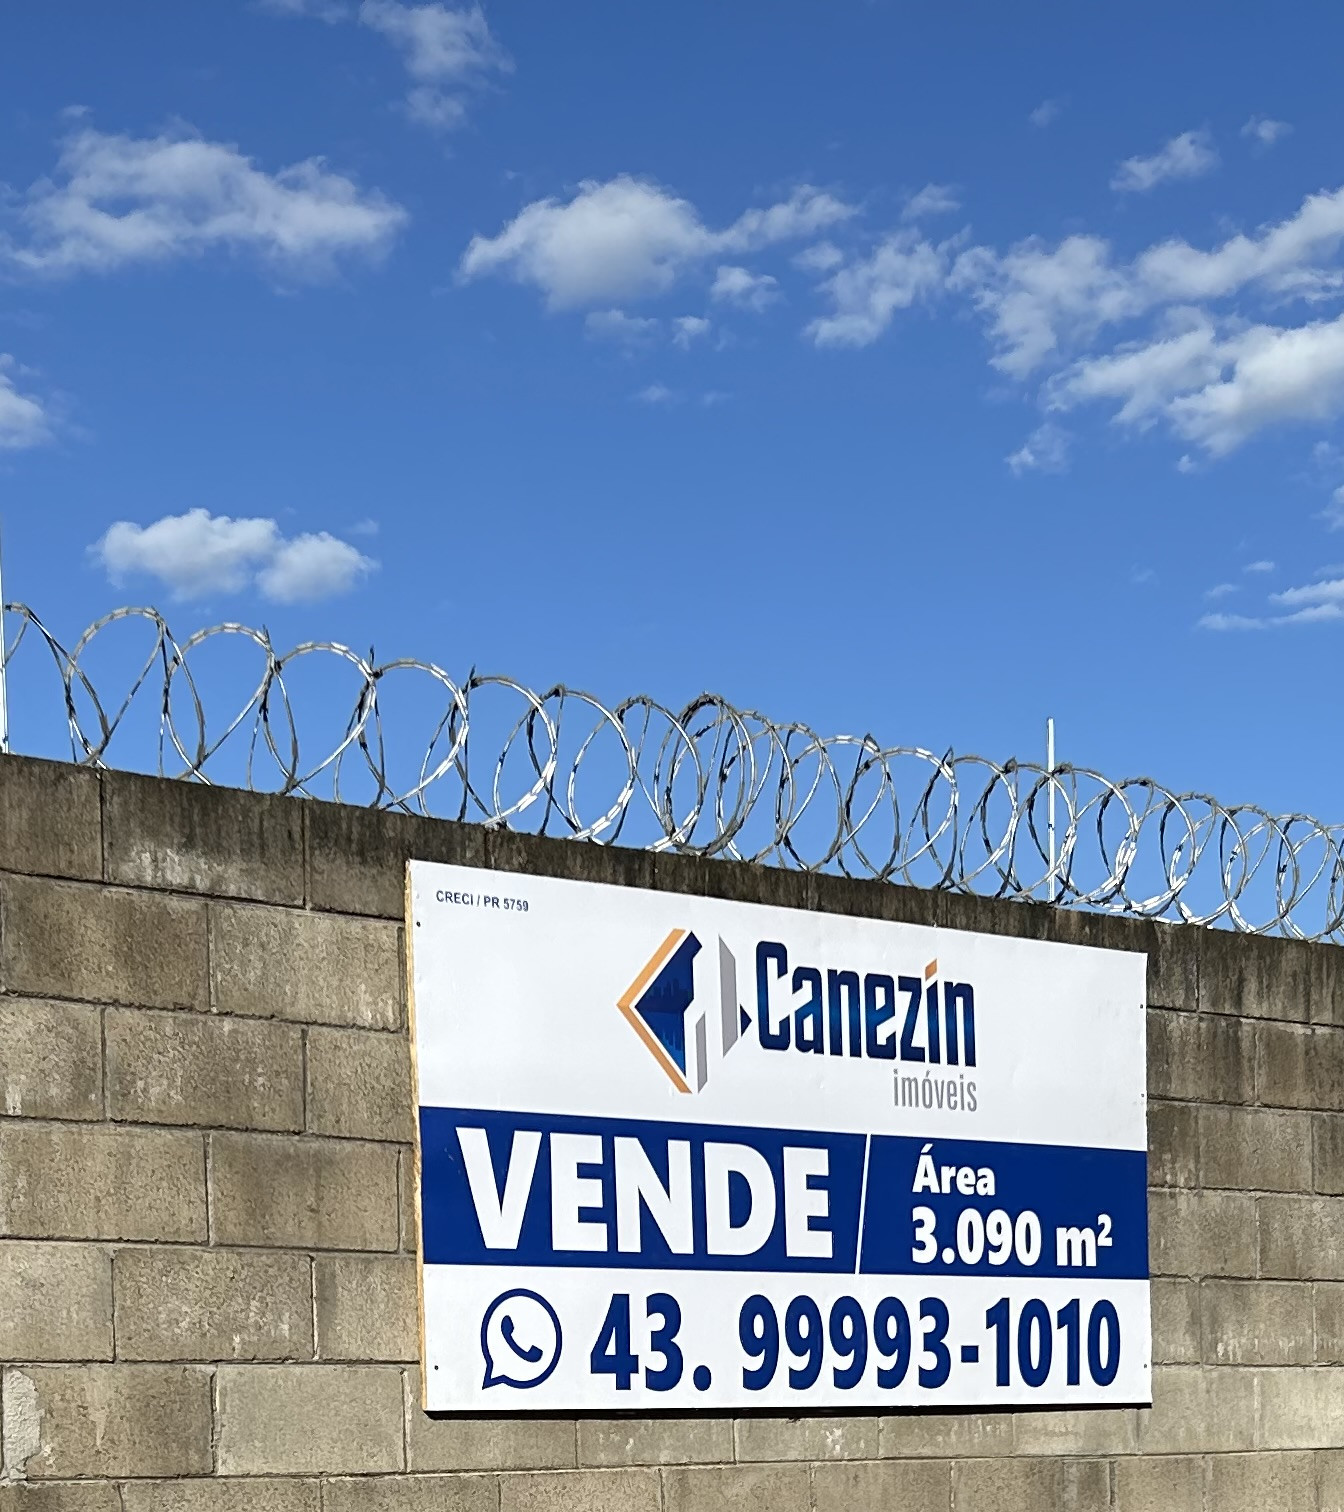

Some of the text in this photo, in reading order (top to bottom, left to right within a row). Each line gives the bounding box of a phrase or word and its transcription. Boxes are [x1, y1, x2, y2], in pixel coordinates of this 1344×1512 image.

[436, 890, 529, 912] CRECI / PR 5759
[755, 940, 977, 1068] Canezin
[892, 1068, 978, 1112] imóveis
[455, 1126, 834, 1259] VENDE
[912, 1143, 996, 1196] Área
[912, 1206, 1113, 1267] 3.090 m²
[590, 1292, 1121, 1392] 43. 99993-1010
